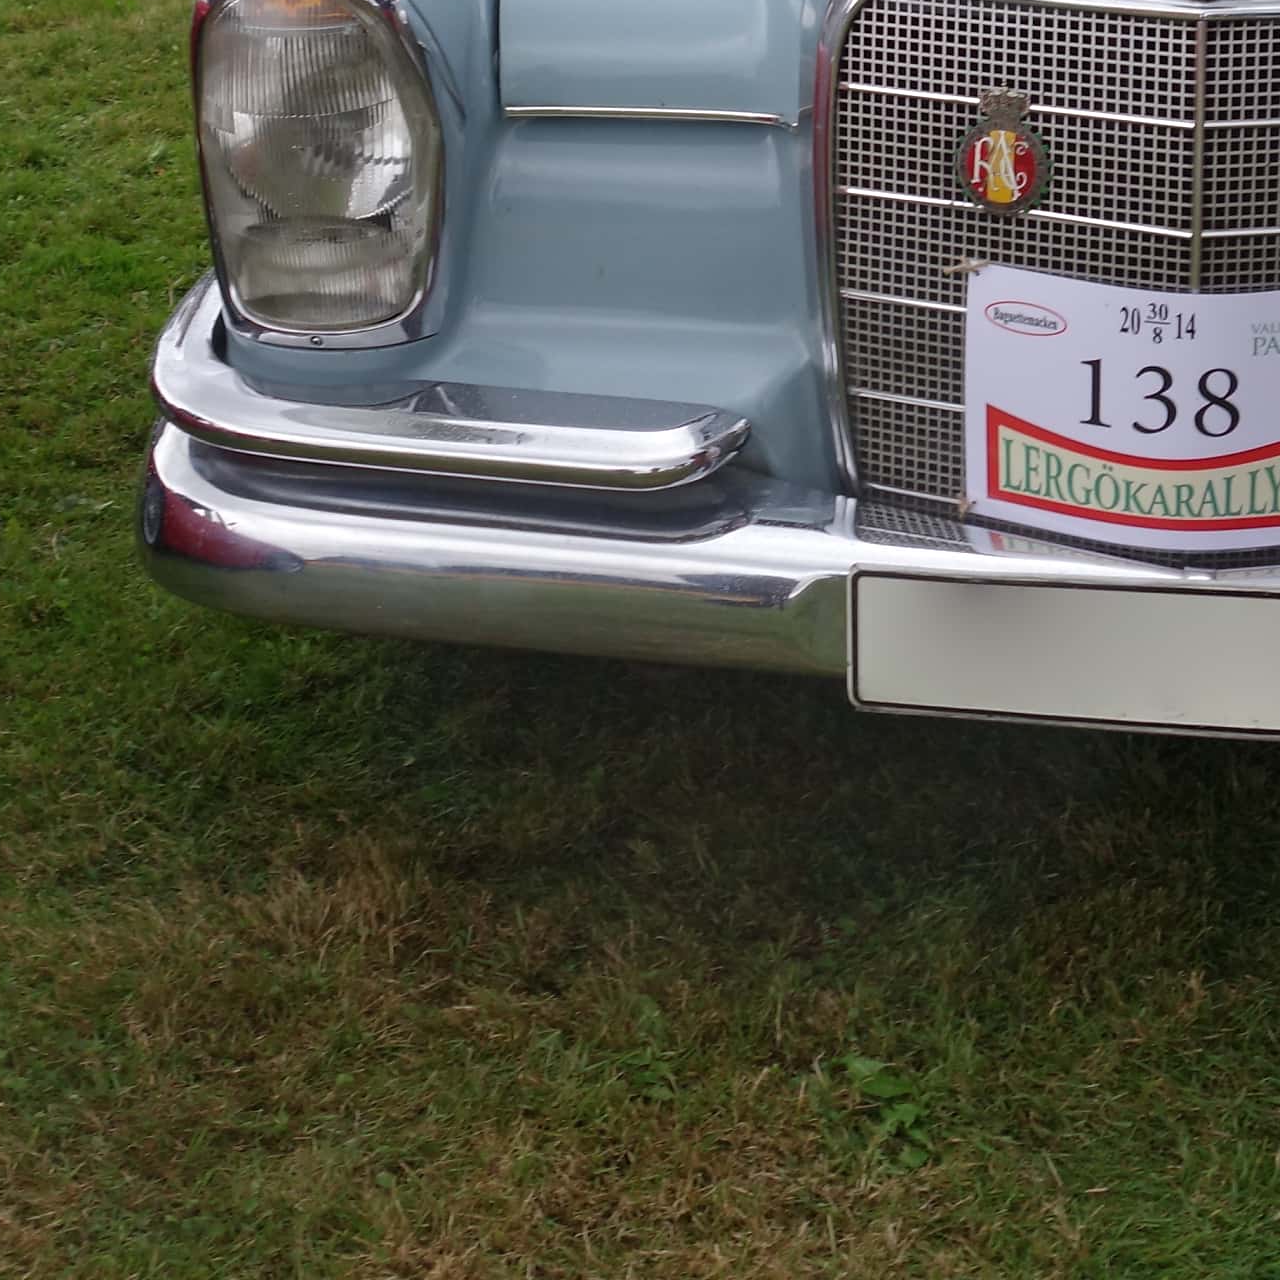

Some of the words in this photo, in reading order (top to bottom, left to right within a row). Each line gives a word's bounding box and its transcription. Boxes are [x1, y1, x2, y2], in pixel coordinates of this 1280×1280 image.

[1119, 306, 1141, 335] 20
[1146, 302, 1169, 321] 30
[1152, 326, 1163, 344] 8
[1175, 312, 1196, 340] 14
[1079, 358, 1241, 438] 138
